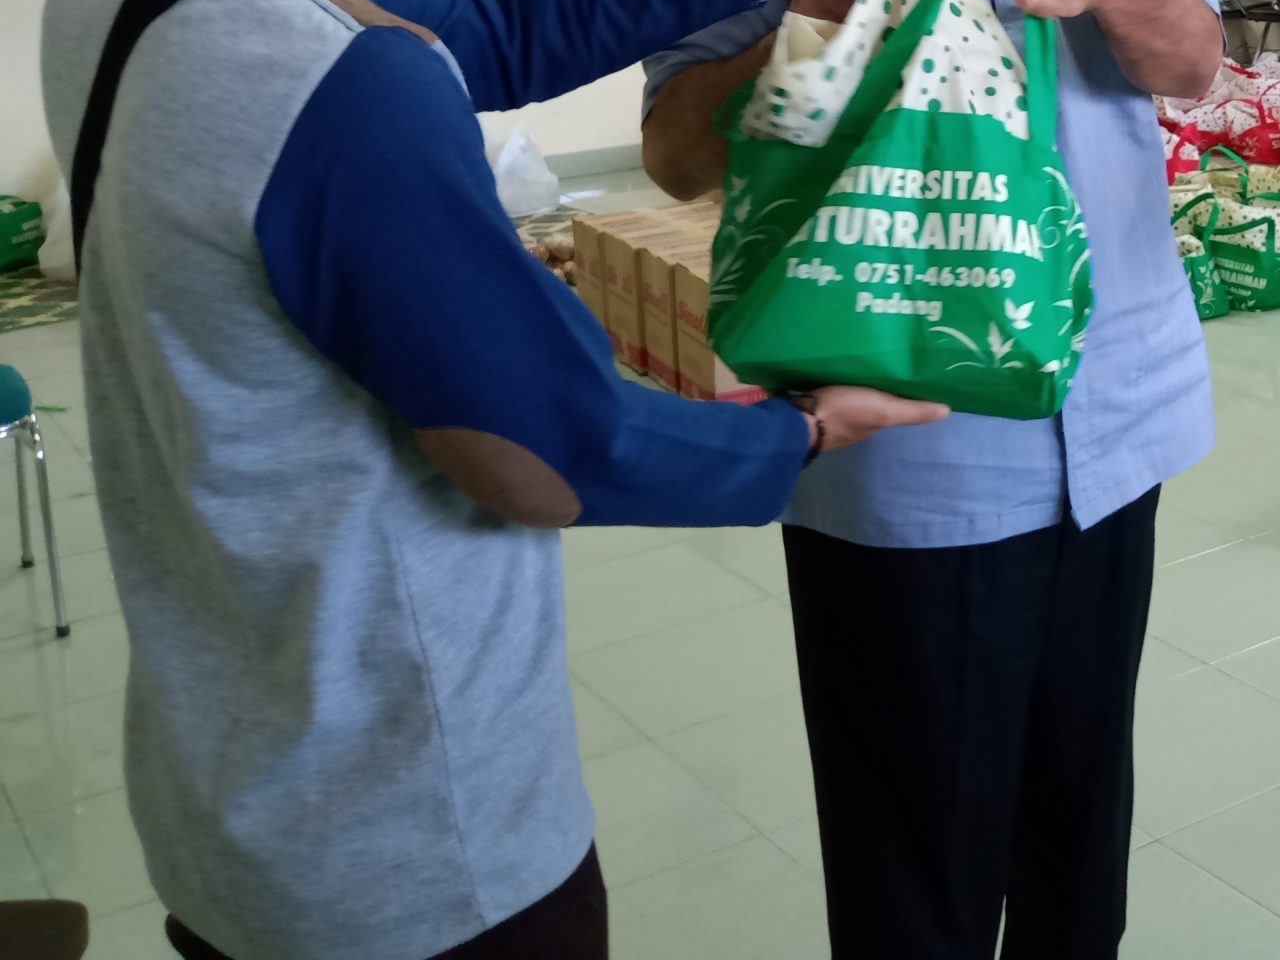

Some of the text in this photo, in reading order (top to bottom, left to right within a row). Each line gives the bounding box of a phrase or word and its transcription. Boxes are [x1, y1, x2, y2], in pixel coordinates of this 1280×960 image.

[786, 258, 1016, 288] Telp. 0751-463069
[855, 292, 943, 322] Padang
